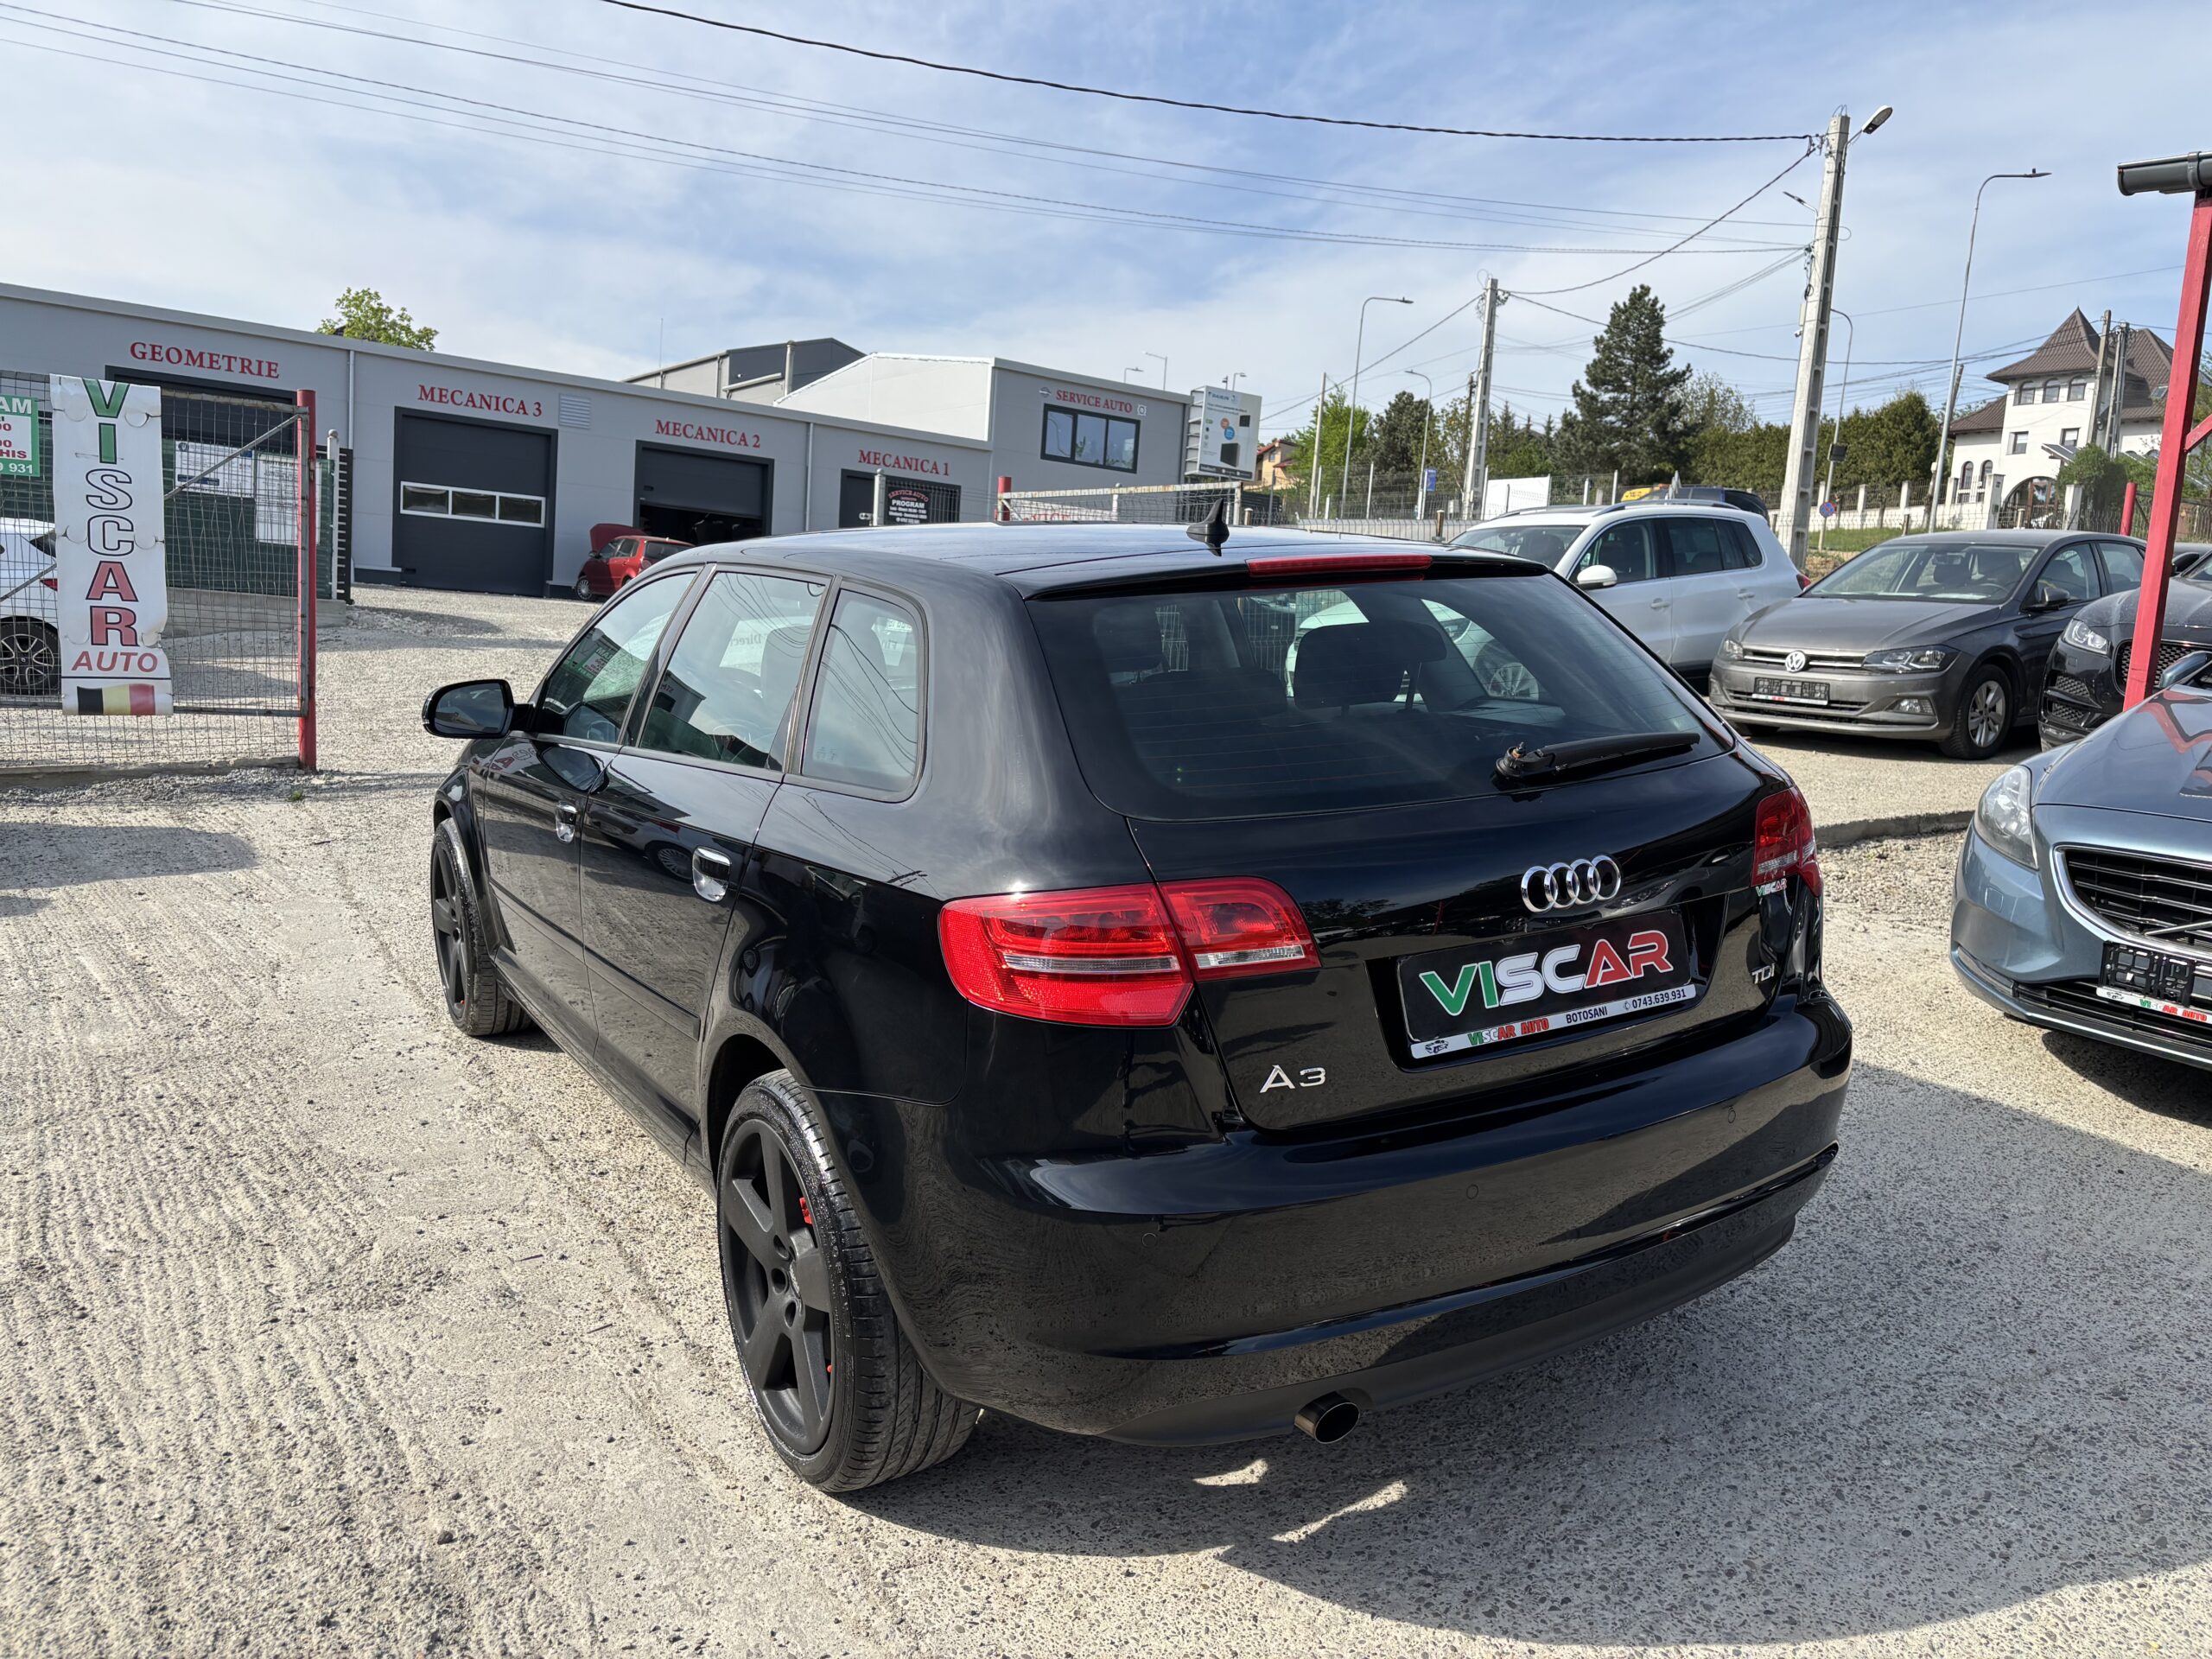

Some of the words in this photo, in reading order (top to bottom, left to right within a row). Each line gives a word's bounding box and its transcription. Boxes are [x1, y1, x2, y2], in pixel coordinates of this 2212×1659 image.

[130, 341, 280, 378] GEOMETRIE
[417, 384, 529, 416] MECANICA
[532, 401, 543, 417] 3
[1056, 389, 1101, 408] SERVICE
[1103, 399, 1133, 414] AUTO
[655, 419, 748, 447] MECANICA
[752, 434, 760, 448] 2
[858, 449, 940, 474] MECANICA
[943, 462, 950, 476] 1
[81, 378, 140, 647] VISCAR
[892, 499, 925, 509] PROGRAM
[71, 651, 158, 673] AUTO
[1755, 878, 1788, 897] VISCAR
[1419, 930, 1674, 1016] VISCAR
[1751, 963, 1776, 985] TDI
[1467, 1025, 1516, 1046] VISCAR
[1521, 1017, 1549, 1035] AUTO
[1566, 1006, 1608, 1024] BOTOSANI
[1631, 988, 1687, 1009] 0743.639.931
[2139, 999, 2177, 1014] VIAR
[2182, 1009, 2207, 1021] AUTO
[1259, 1064, 1327, 1095] A3
